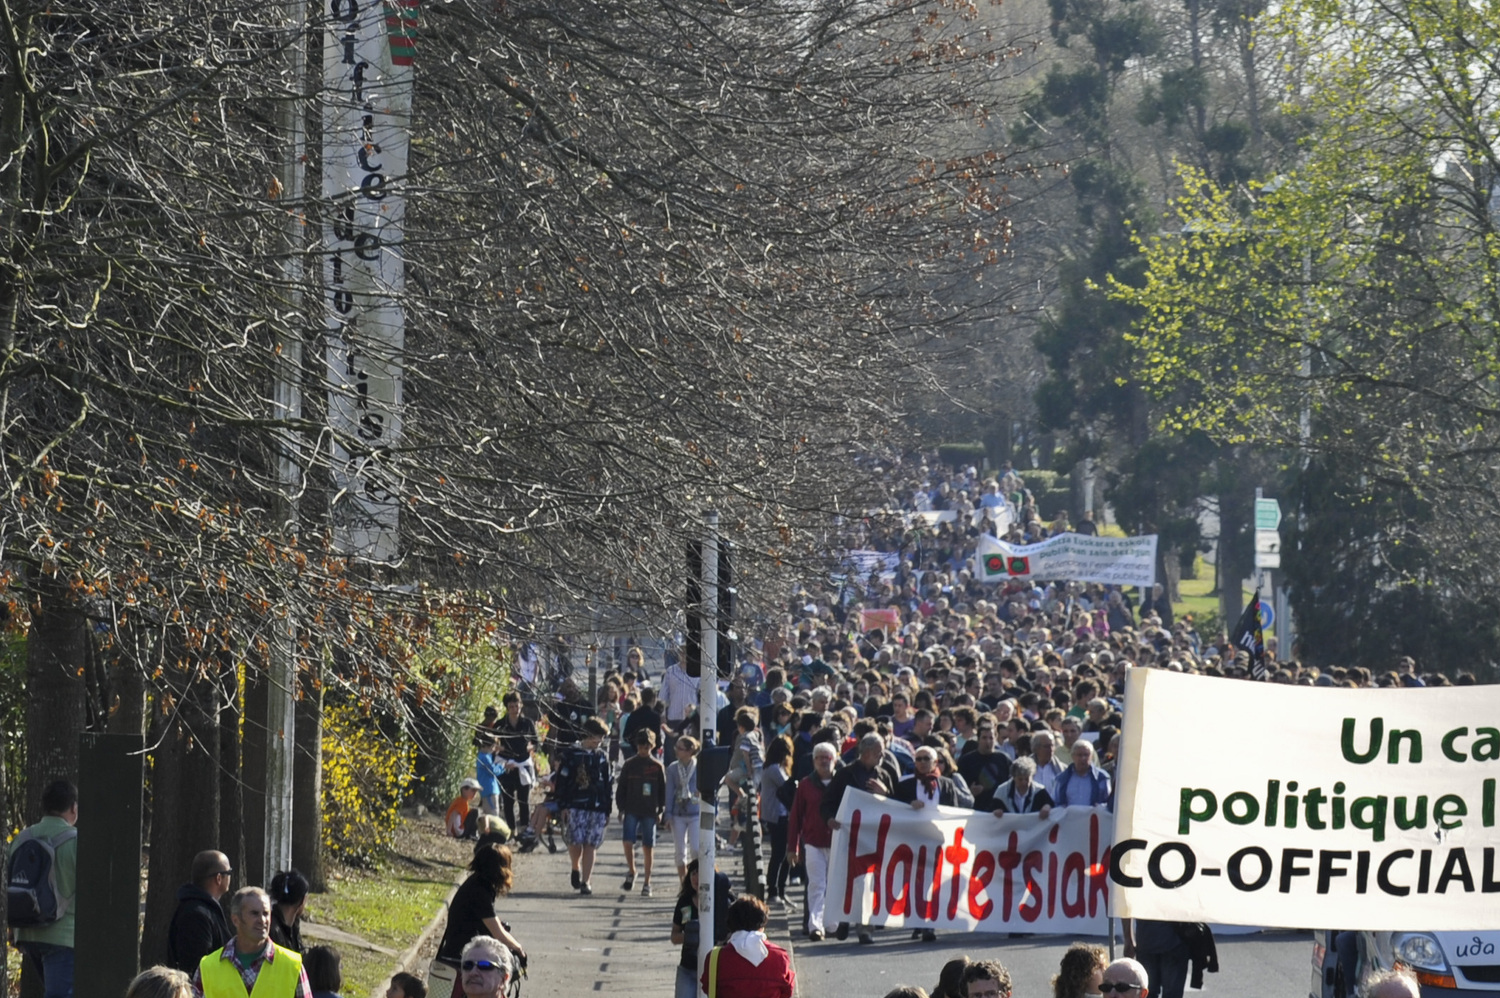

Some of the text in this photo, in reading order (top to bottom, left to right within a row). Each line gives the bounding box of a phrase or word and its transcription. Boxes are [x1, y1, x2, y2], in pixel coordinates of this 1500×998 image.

[1340, 717, 1423, 765] Un
[1177, 779, 1468, 843] politique
[843, 810, 1111, 924] Hautetsiak
